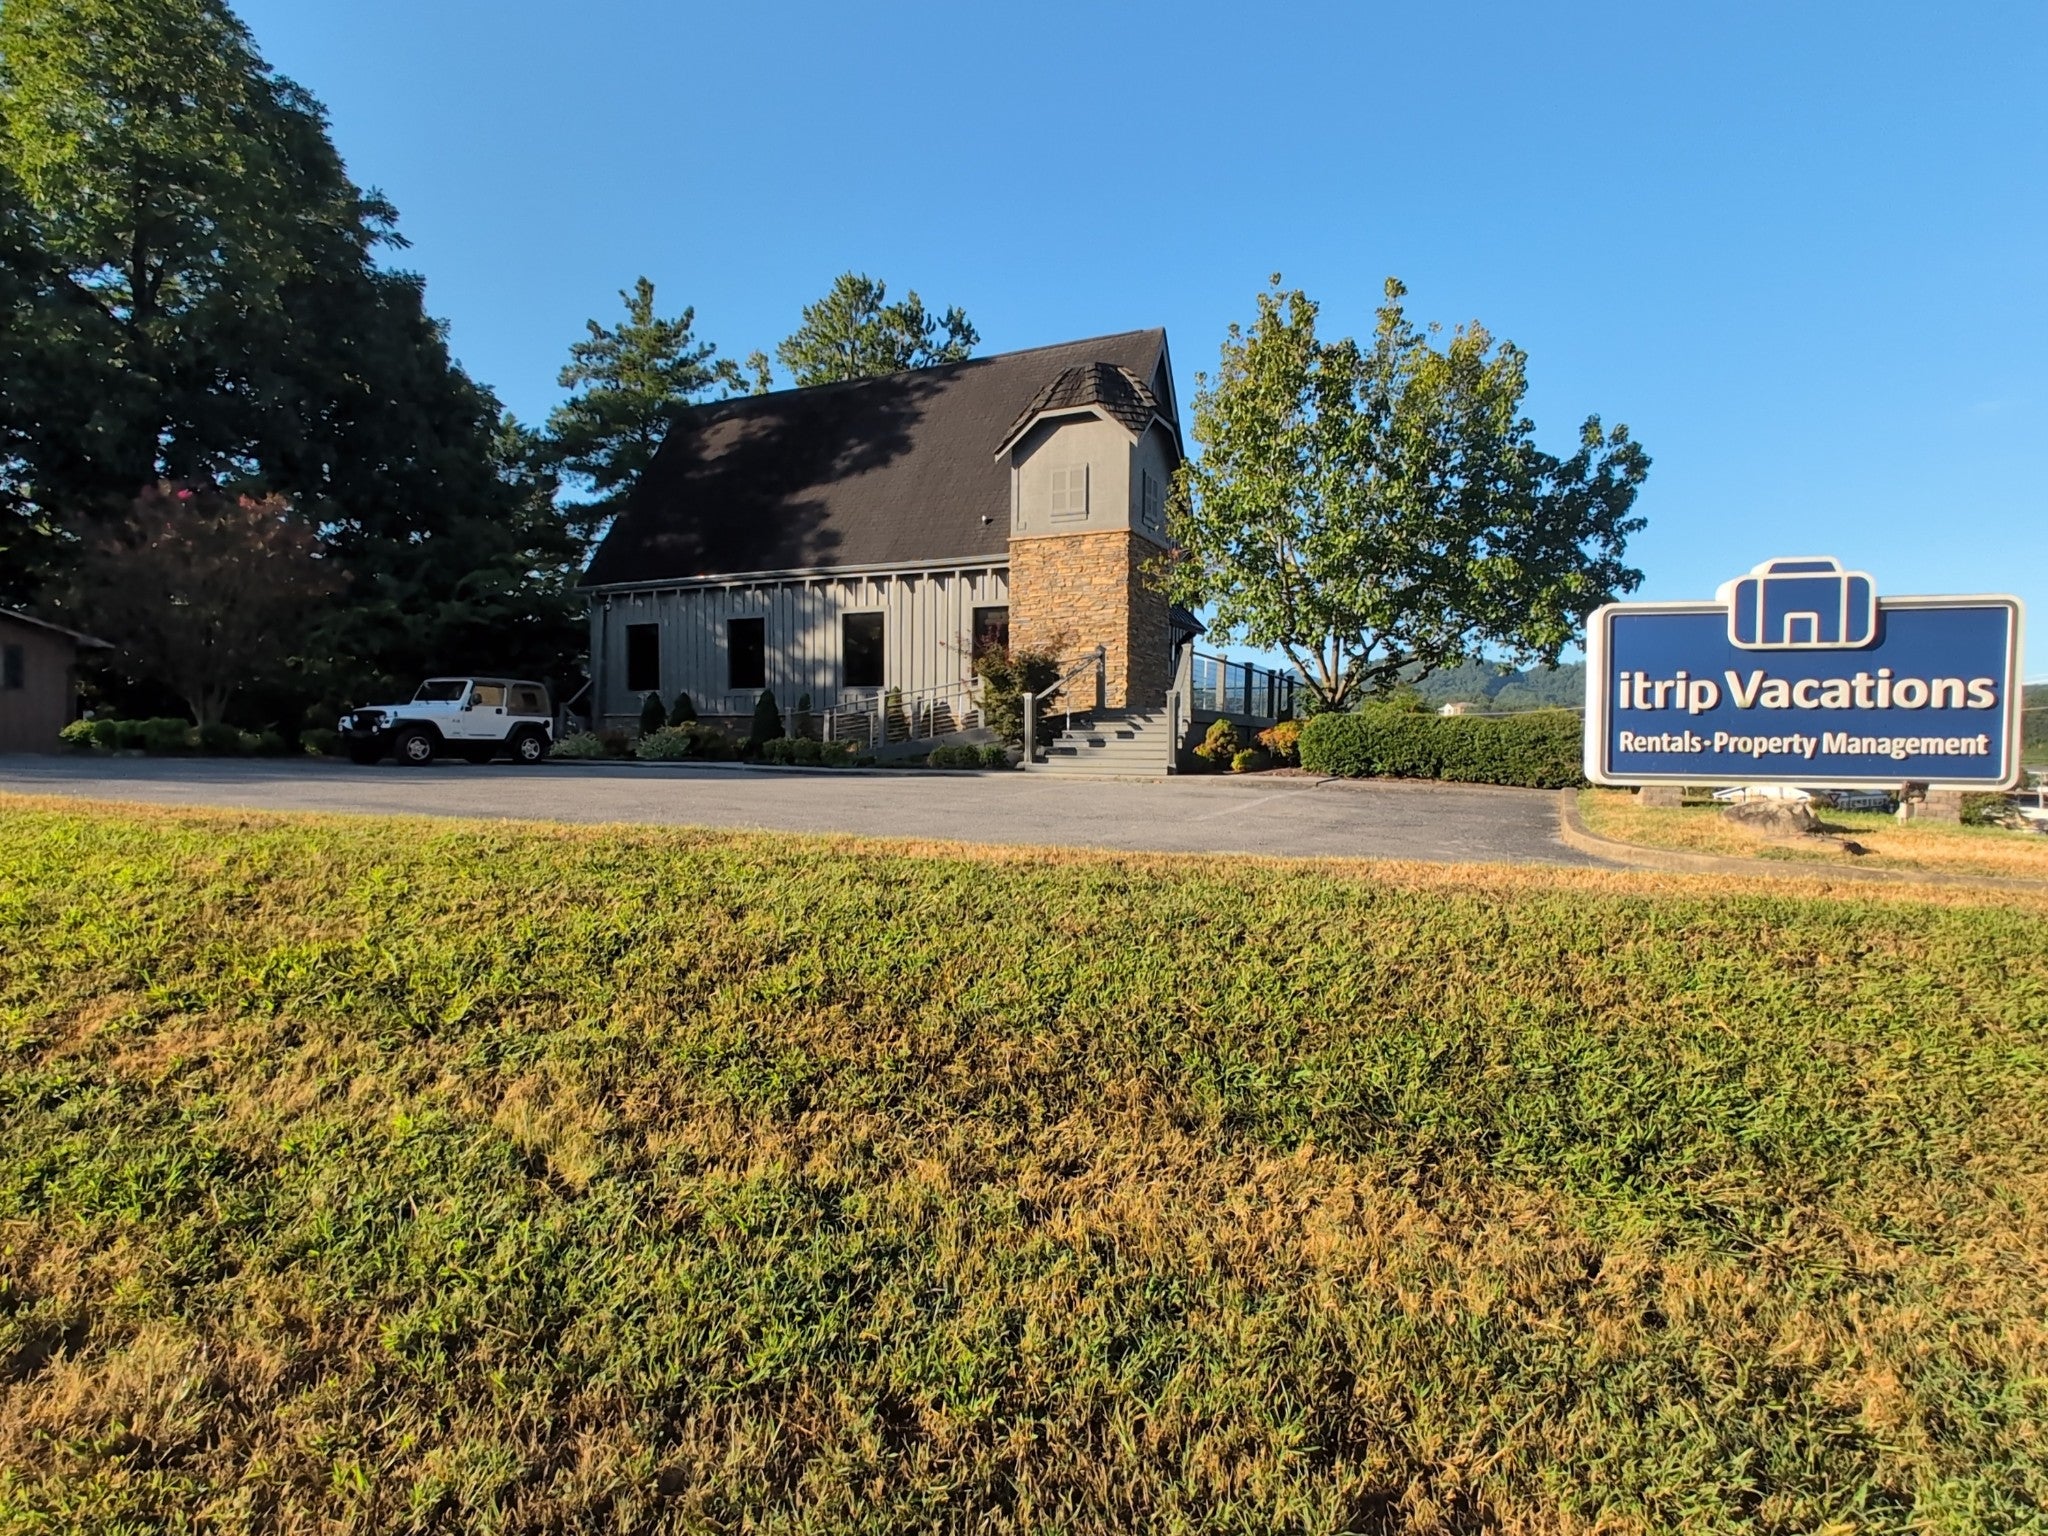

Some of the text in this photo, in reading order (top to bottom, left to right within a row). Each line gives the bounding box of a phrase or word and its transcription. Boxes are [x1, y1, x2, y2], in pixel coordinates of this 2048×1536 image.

[1619, 668, 1996, 715] itrip Vacations
[1821, 731, 1990, 760] Management
